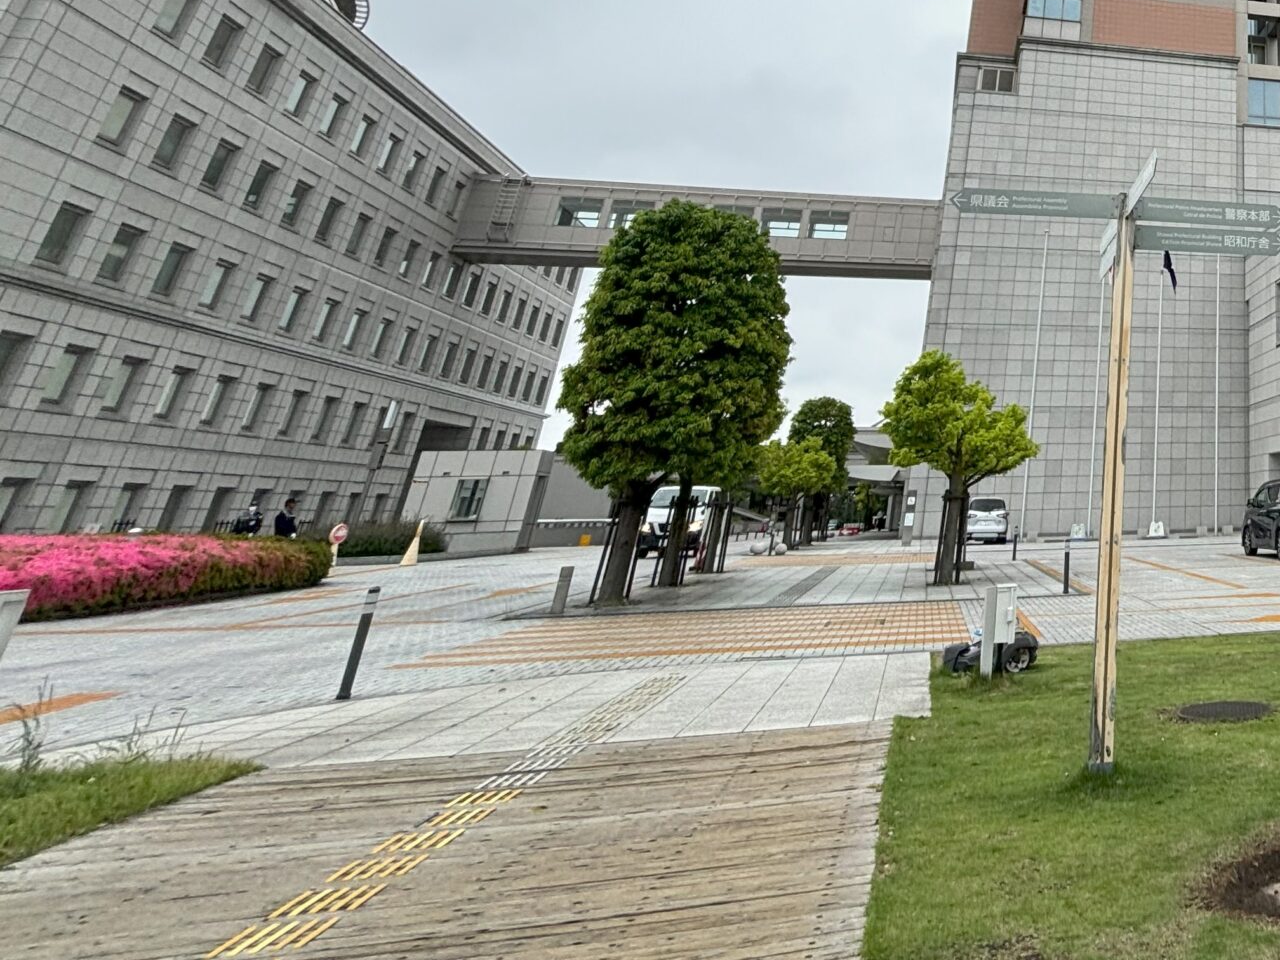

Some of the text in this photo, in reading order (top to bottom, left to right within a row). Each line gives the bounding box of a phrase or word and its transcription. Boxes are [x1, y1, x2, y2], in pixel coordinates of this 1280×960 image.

[970, 194, 1009, 208] 県議会
[1224, 207, 1270, 221] 警察本部
[1224, 235, 1270, 249] 昭和庁舎
